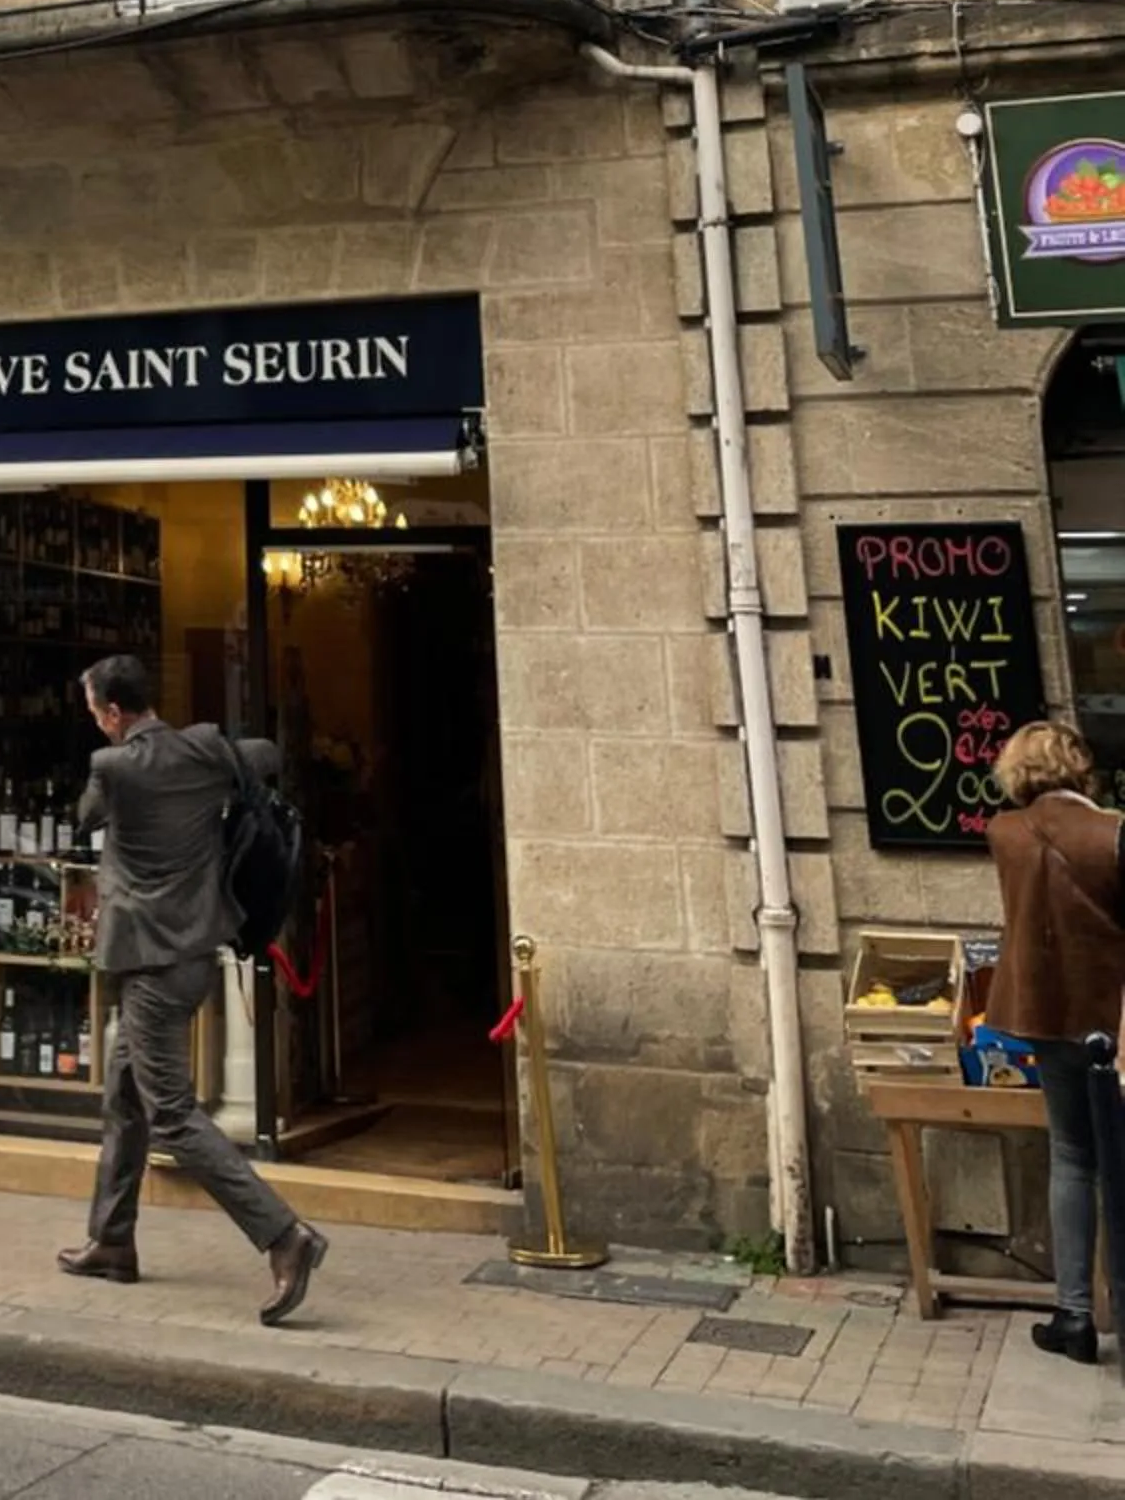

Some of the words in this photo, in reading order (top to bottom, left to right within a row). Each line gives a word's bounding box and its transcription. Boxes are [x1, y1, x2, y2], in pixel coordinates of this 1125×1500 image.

[62, 345, 208, 394] SAINT
[222, 335, 410, 386] SEURIN
[855, 535, 1012, 581] PROMO
[872, 590, 1013, 642] KIWI
[879, 659, 1009, 707] VERT
